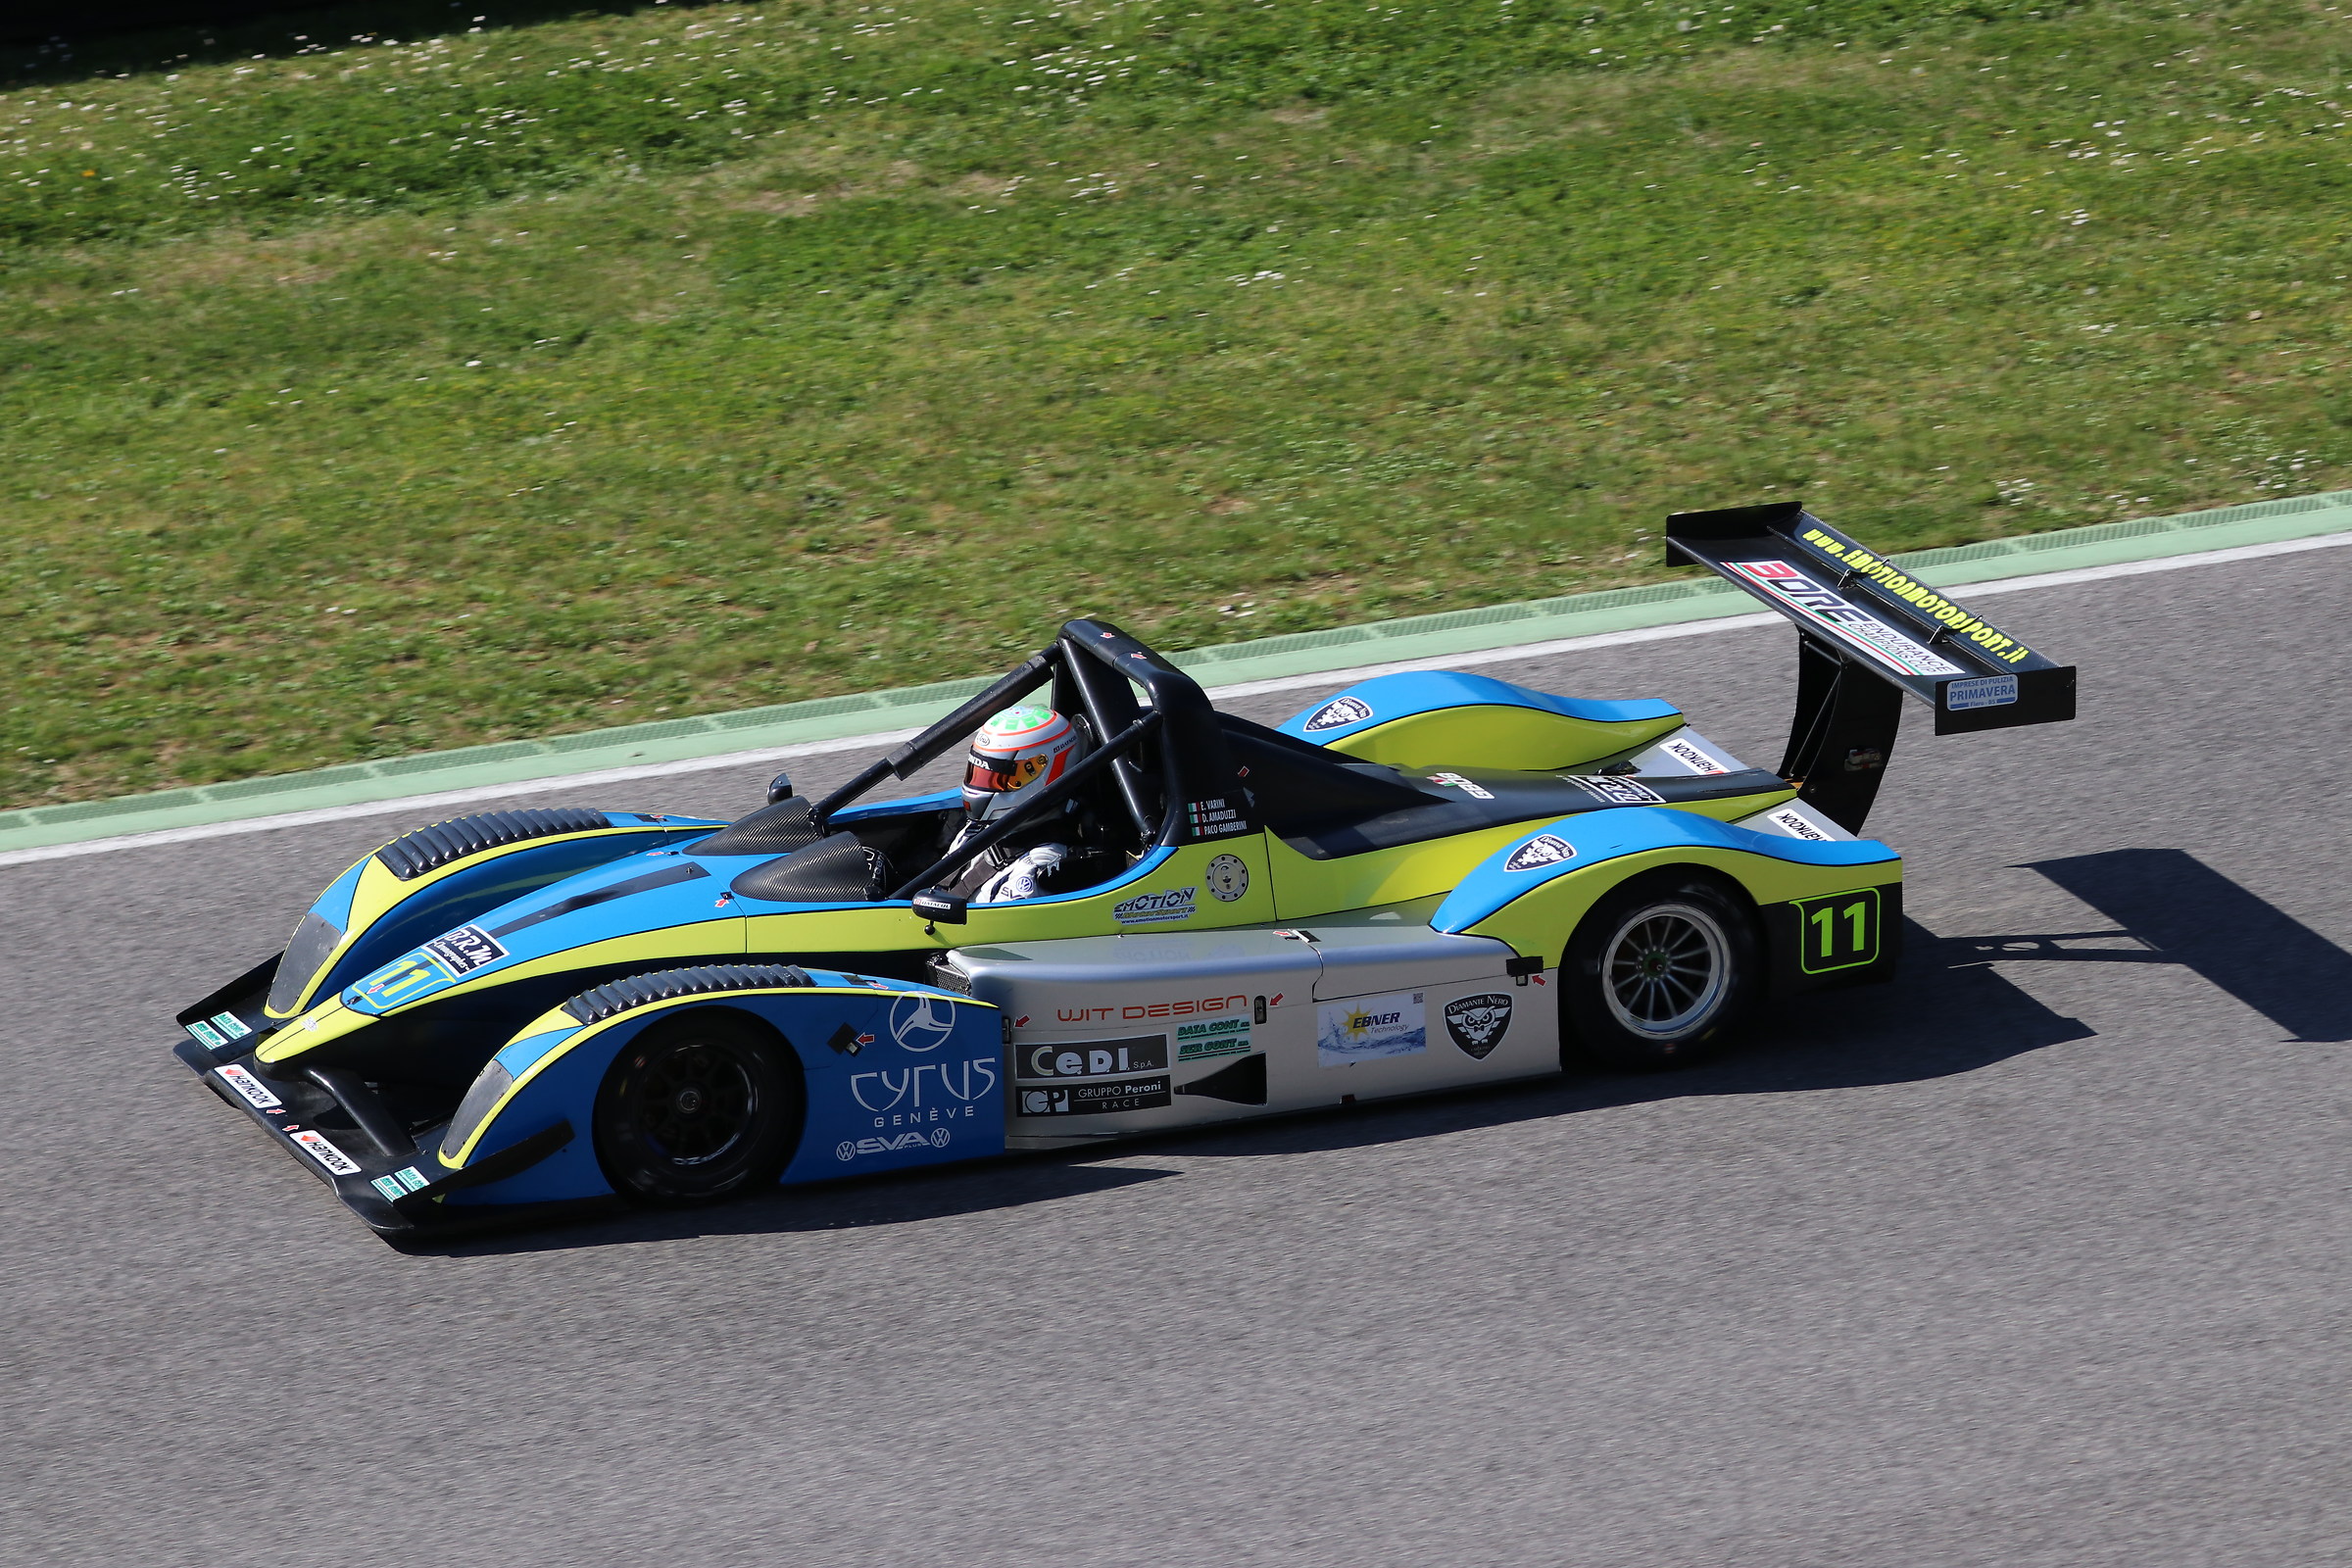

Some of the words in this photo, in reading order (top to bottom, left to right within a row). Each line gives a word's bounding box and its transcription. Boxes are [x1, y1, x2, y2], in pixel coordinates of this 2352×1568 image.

[1862, 623, 1953, 672] ENDURANCE
[1951, 679, 1979, 689] IMPRESE
[1988, 676, 2014, 685] PULIZIA
[1950, 685, 2015, 702] PRIMAVERA
[1209, 809, 1237, 822] AMADUZZI
[1204, 824, 1218, 835] PACO
[1219, 820, 1248, 833] GAMBERINI
[1114, 888, 1196, 912] EMOTION
[1811, 902, 1866, 957] 11
[369, 960, 431, 998] 11
[1057, 1007, 1114, 1022] WIT
[1122, 995, 1248, 1020] DESIGN
[1177, 1024, 1206, 1036] DATA
[1209, 1019, 1240, 1032] CONT
[1352, 1012, 1400, 1029] EBNER
[1371, 1023, 1410, 1034] Technology
[1204, 1038, 1237, 1052] CONT
[1078, 1086, 1122, 1099] GRUPPO
[1125, 1081, 1161, 1095] Peroni
[874, 1104, 974, 1128] GENÈVE
[857, 1131, 931, 1154] SVA
